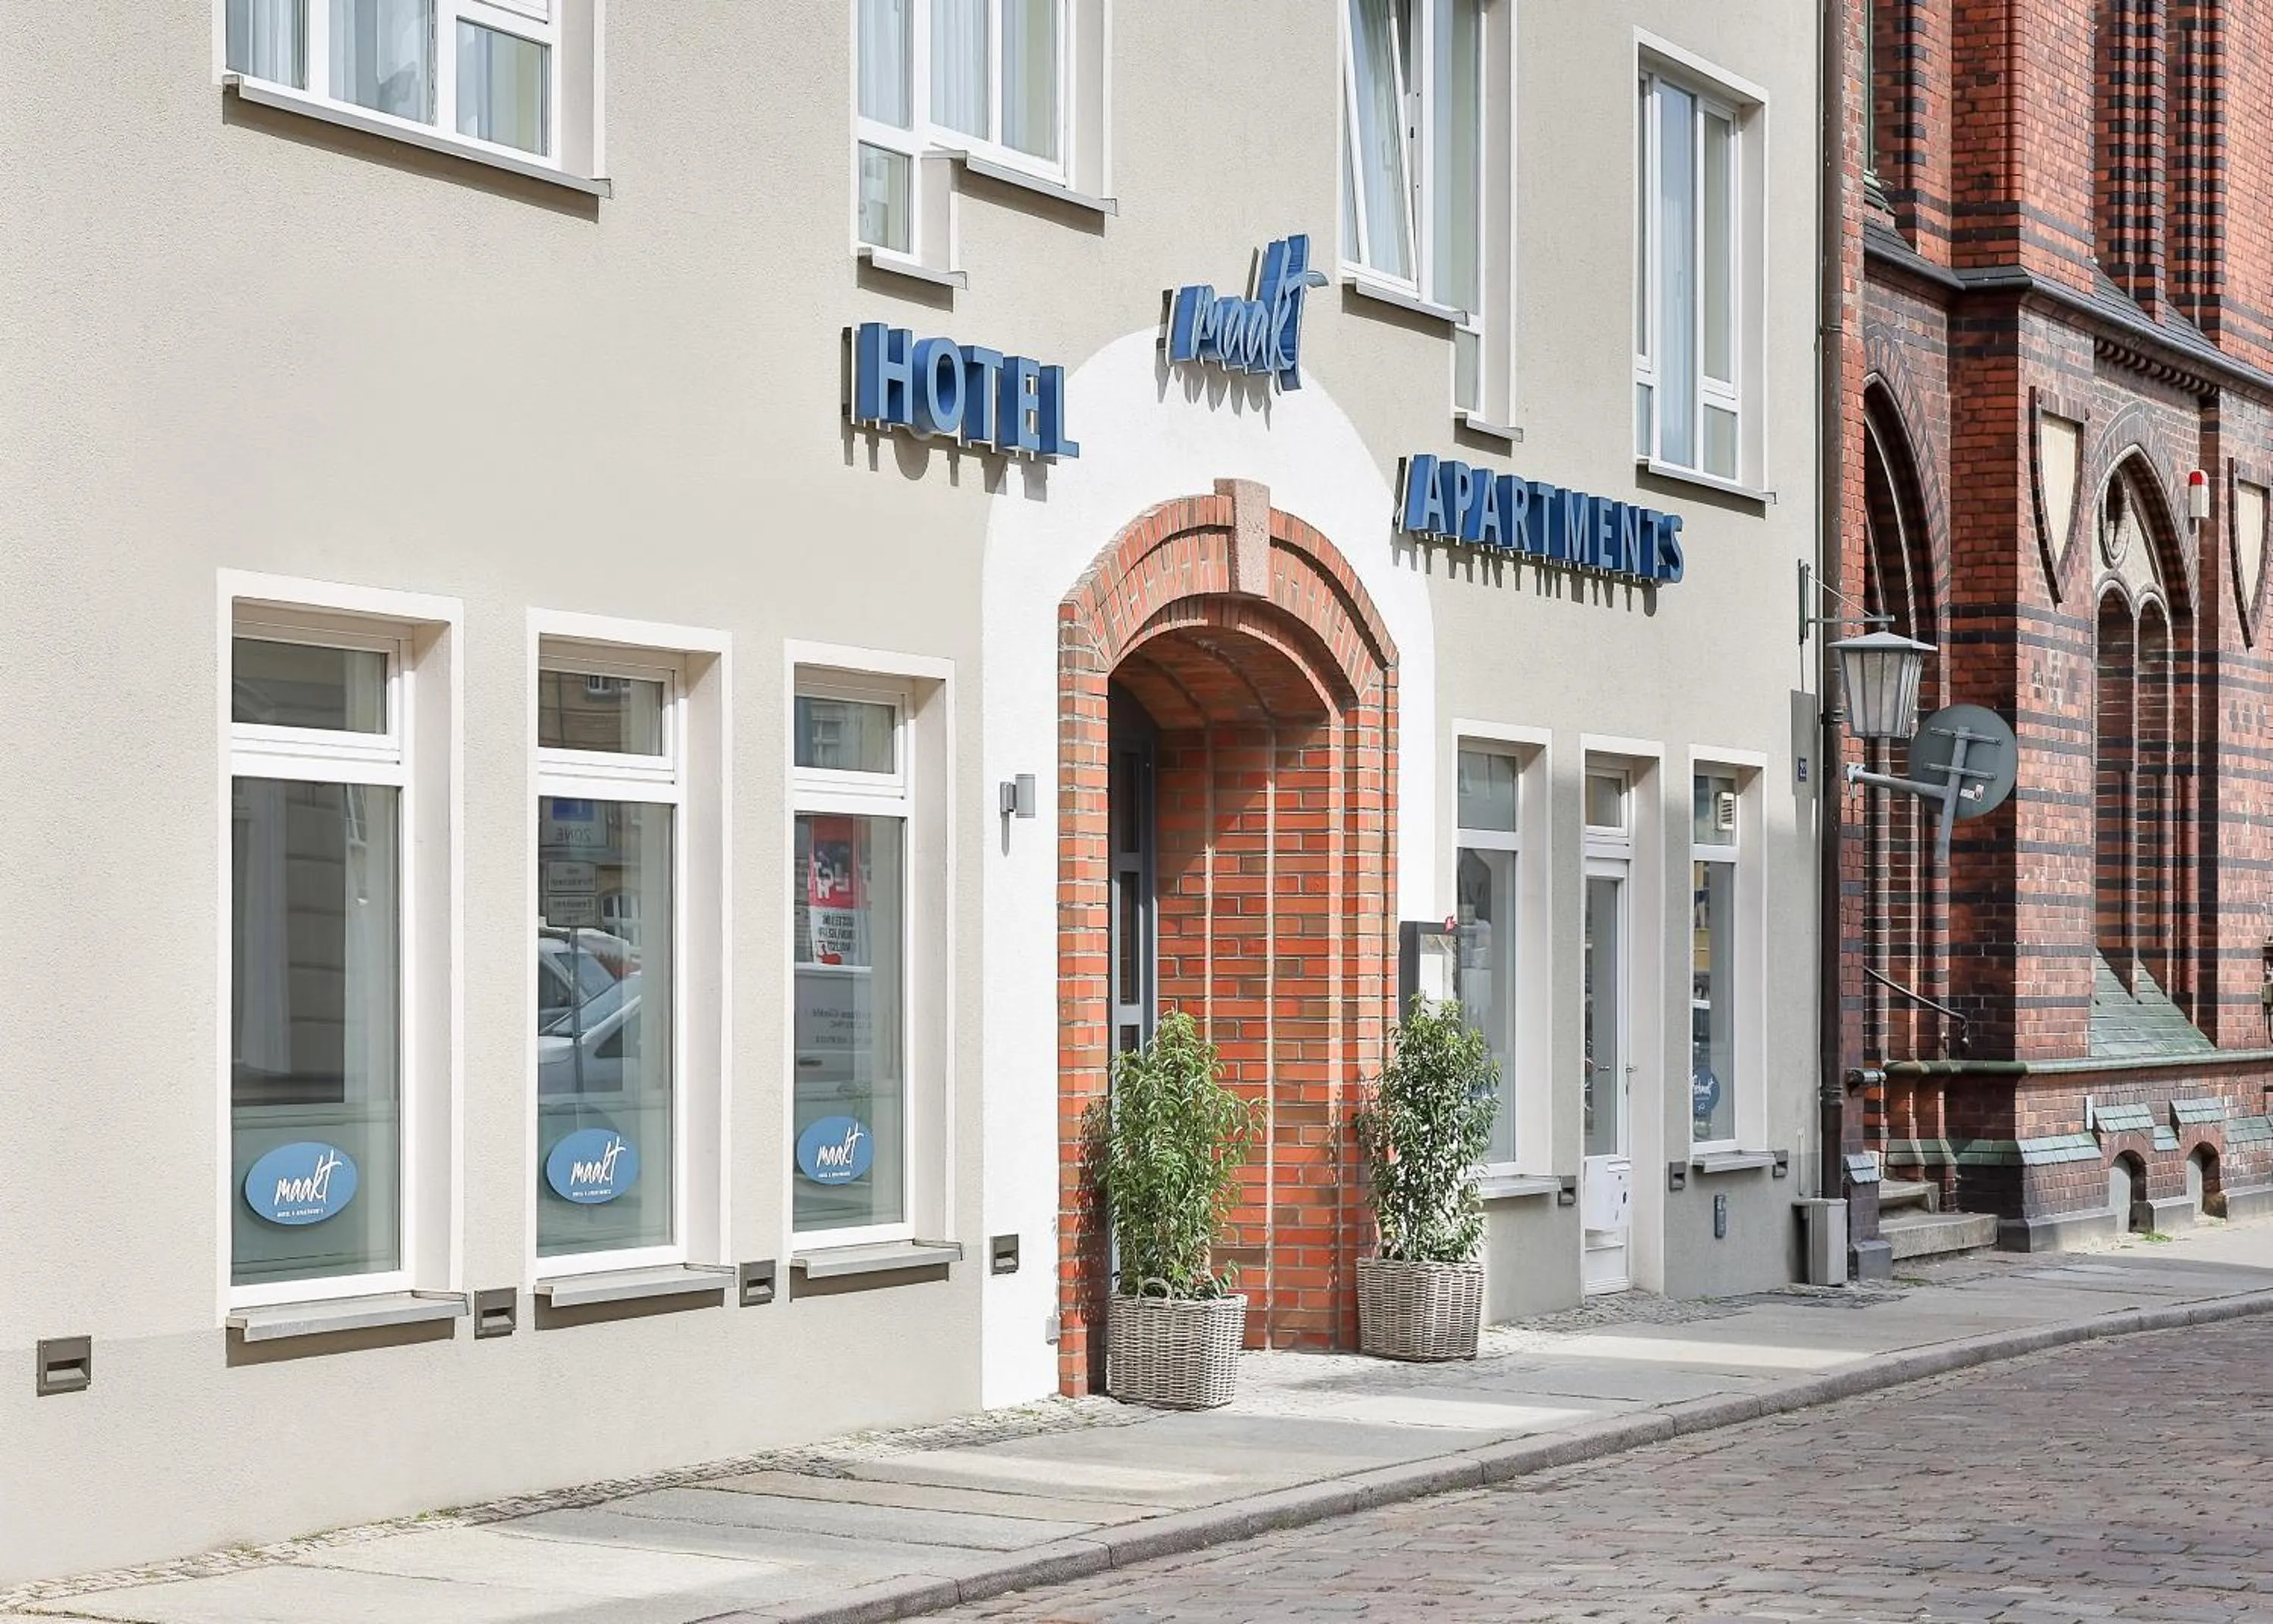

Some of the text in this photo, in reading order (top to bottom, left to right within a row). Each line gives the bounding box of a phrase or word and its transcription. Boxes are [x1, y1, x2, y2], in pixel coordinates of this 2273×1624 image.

[858, 322, 1080, 459] HOTEL
[1405, 454, 1685, 583] APARTMENTS
[571, 1135, 627, 1185] maakt
[816, 1122, 864, 1168] maakt
[274, 1148, 342, 1206] maakt
